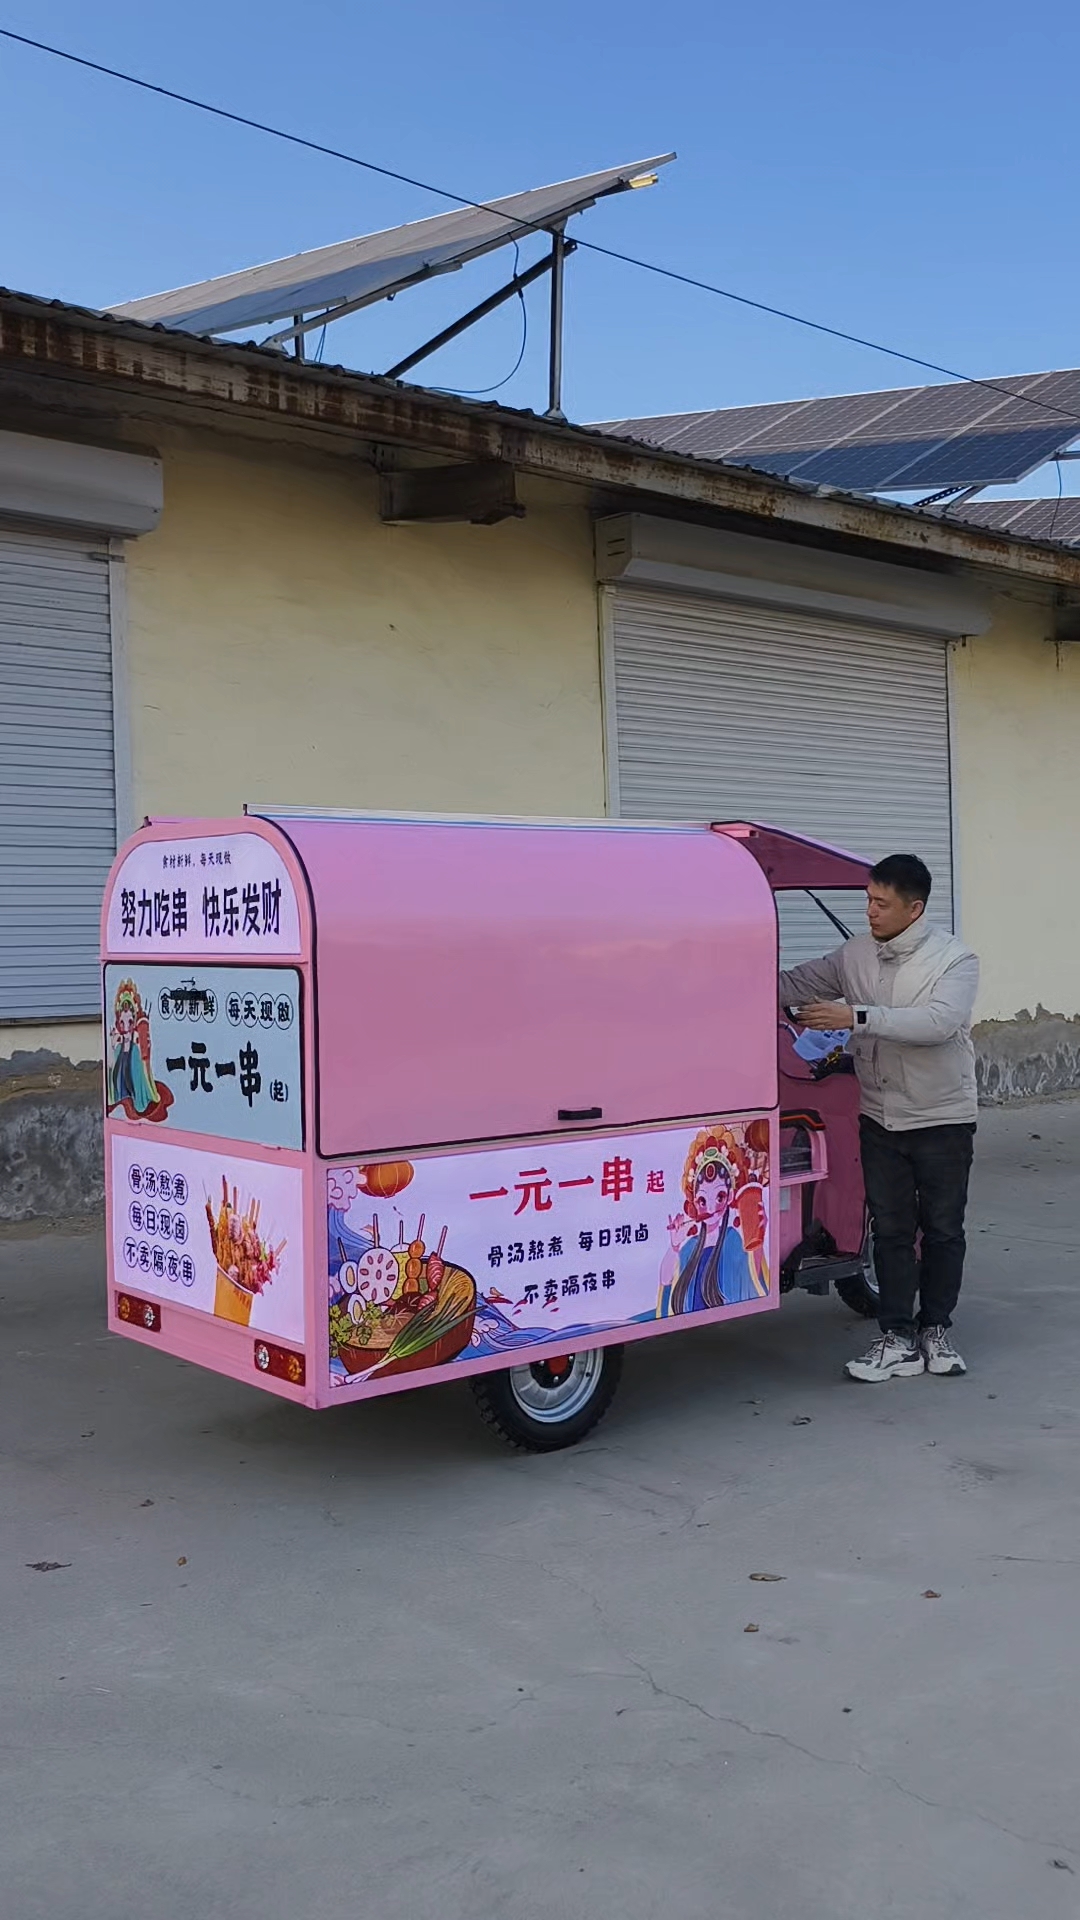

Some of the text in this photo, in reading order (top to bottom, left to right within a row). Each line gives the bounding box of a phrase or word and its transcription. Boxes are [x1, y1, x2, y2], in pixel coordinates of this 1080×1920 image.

[121, 878, 282, 938] 努力吃串 快乐发财
[228, 996, 291, 1025] 每天现做
[166, 1041, 261, 1108] 一元一串
[130, 1166, 187, 1202] 骨汤熬煮
[469, 1156, 665, 1216] 一元一串 起
[131, 1204, 187, 1242] 每日现卤
[125, 1240, 194, 1284] 不卖隔夜串
[487, 1223, 650, 1268] 骨汤熬煮 每日现卤
[524, 1270, 616, 1305] 不卖隔夜串
